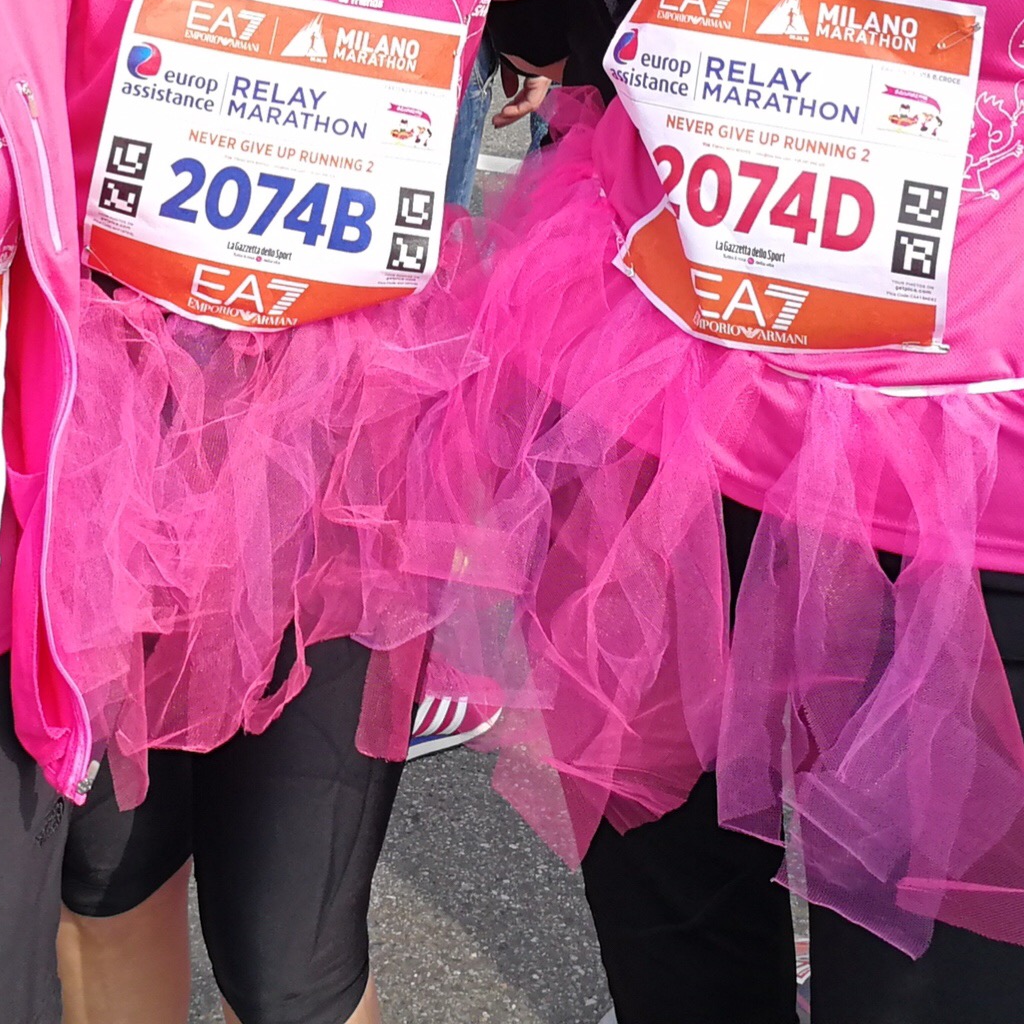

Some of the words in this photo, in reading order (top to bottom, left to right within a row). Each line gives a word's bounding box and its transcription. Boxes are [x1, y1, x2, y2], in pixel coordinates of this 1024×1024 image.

[186, 0, 266, 41] EA7
[657, 10, 691, 24] EMPORIO
[700, 17, 731, 31] ARMANI
[818, 2, 918, 38] MILANO
[184, 30, 221, 46] EMPORIO
[231, 38, 260, 53] ARMANI
[336, 27, 420, 60] MILANO
[816, 24, 917, 53] MARATHON
[333, 47, 417, 72] MARATHON
[640, 52, 691, 76] europ
[705, 56, 812, 93] RELAY
[121, 81, 215, 112] assistance
[164, 70, 218, 94] europ
[231, 75, 327, 111] RELAY
[610, 68, 689, 96] assistance
[227, 99, 368, 140] MARATHON
[702, 81, 860, 125] MARATHON
[189, 129, 237, 150] NEVER
[240, 139, 274, 157] GIVE
[277, 146, 296, 160] UP
[299, 150, 363, 173] RUNNING
[366, 160, 375, 173] 2
[666, 114, 714, 136] NEVER
[718, 125, 754, 143] GIVE
[759, 132, 779, 149] UP
[784, 136, 856, 160] RUNNING
[861, 149, 871, 162] 2
[159, 157, 377, 254] 2074B
[652, 144, 875, 252] 2074D
[724, 241, 751, 256] Gazzetta
[767, 249, 785, 263] Sport
[190, 263, 309, 315] EA7
[690, 267, 810, 332] EA7
[187, 296, 240, 318] EMPORIO
[251, 314, 298, 326] ARMANI
[757, 329, 808, 345] ARMANI
